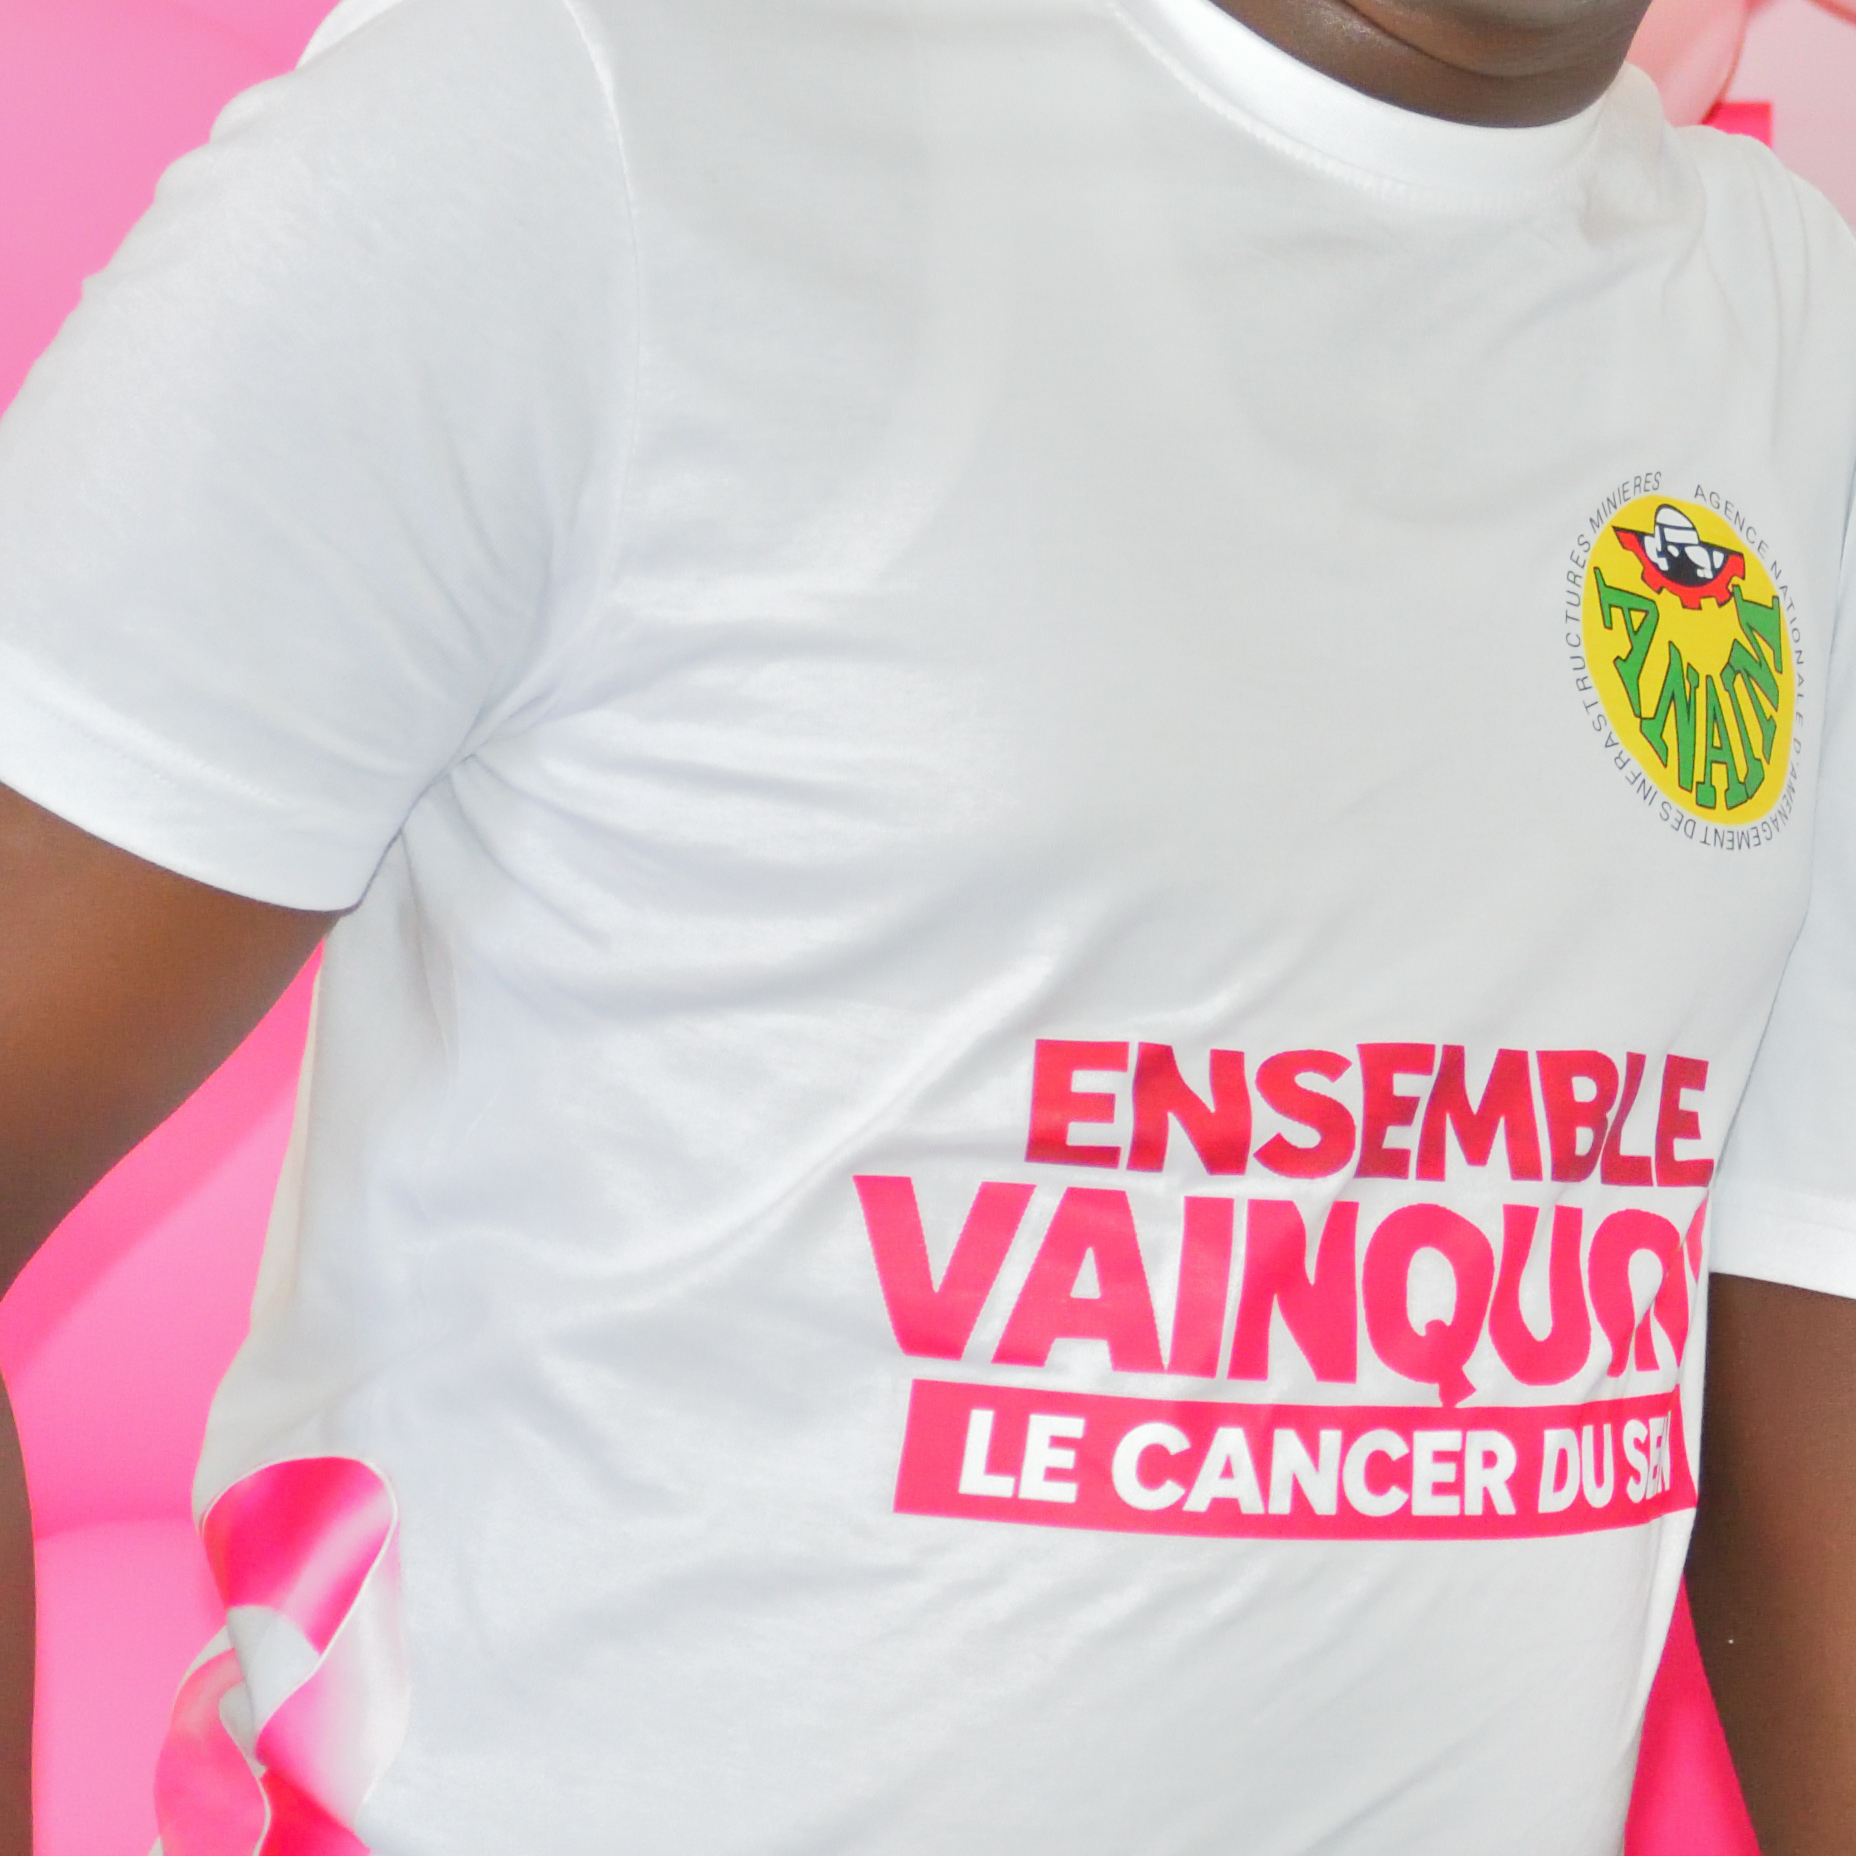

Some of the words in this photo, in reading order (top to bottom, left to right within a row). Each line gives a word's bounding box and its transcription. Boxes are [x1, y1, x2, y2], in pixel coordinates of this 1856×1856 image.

[1589, 471, 1662, 532] MINIERES
[1694, 484, 1769, 559] AGENCE
[1566, 534, 1658, 805] INFRASTRUCTURES
[1594, 566, 1783, 810] ANAIM
[1771, 560, 1804, 726] NATIONALE
[1660, 801, 1697, 838] DES
[958, 1410, 1085, 1504] LE
[1112, 1423, 1517, 1516] CANCER
[1538, 1423, 1616, 1514] DU
